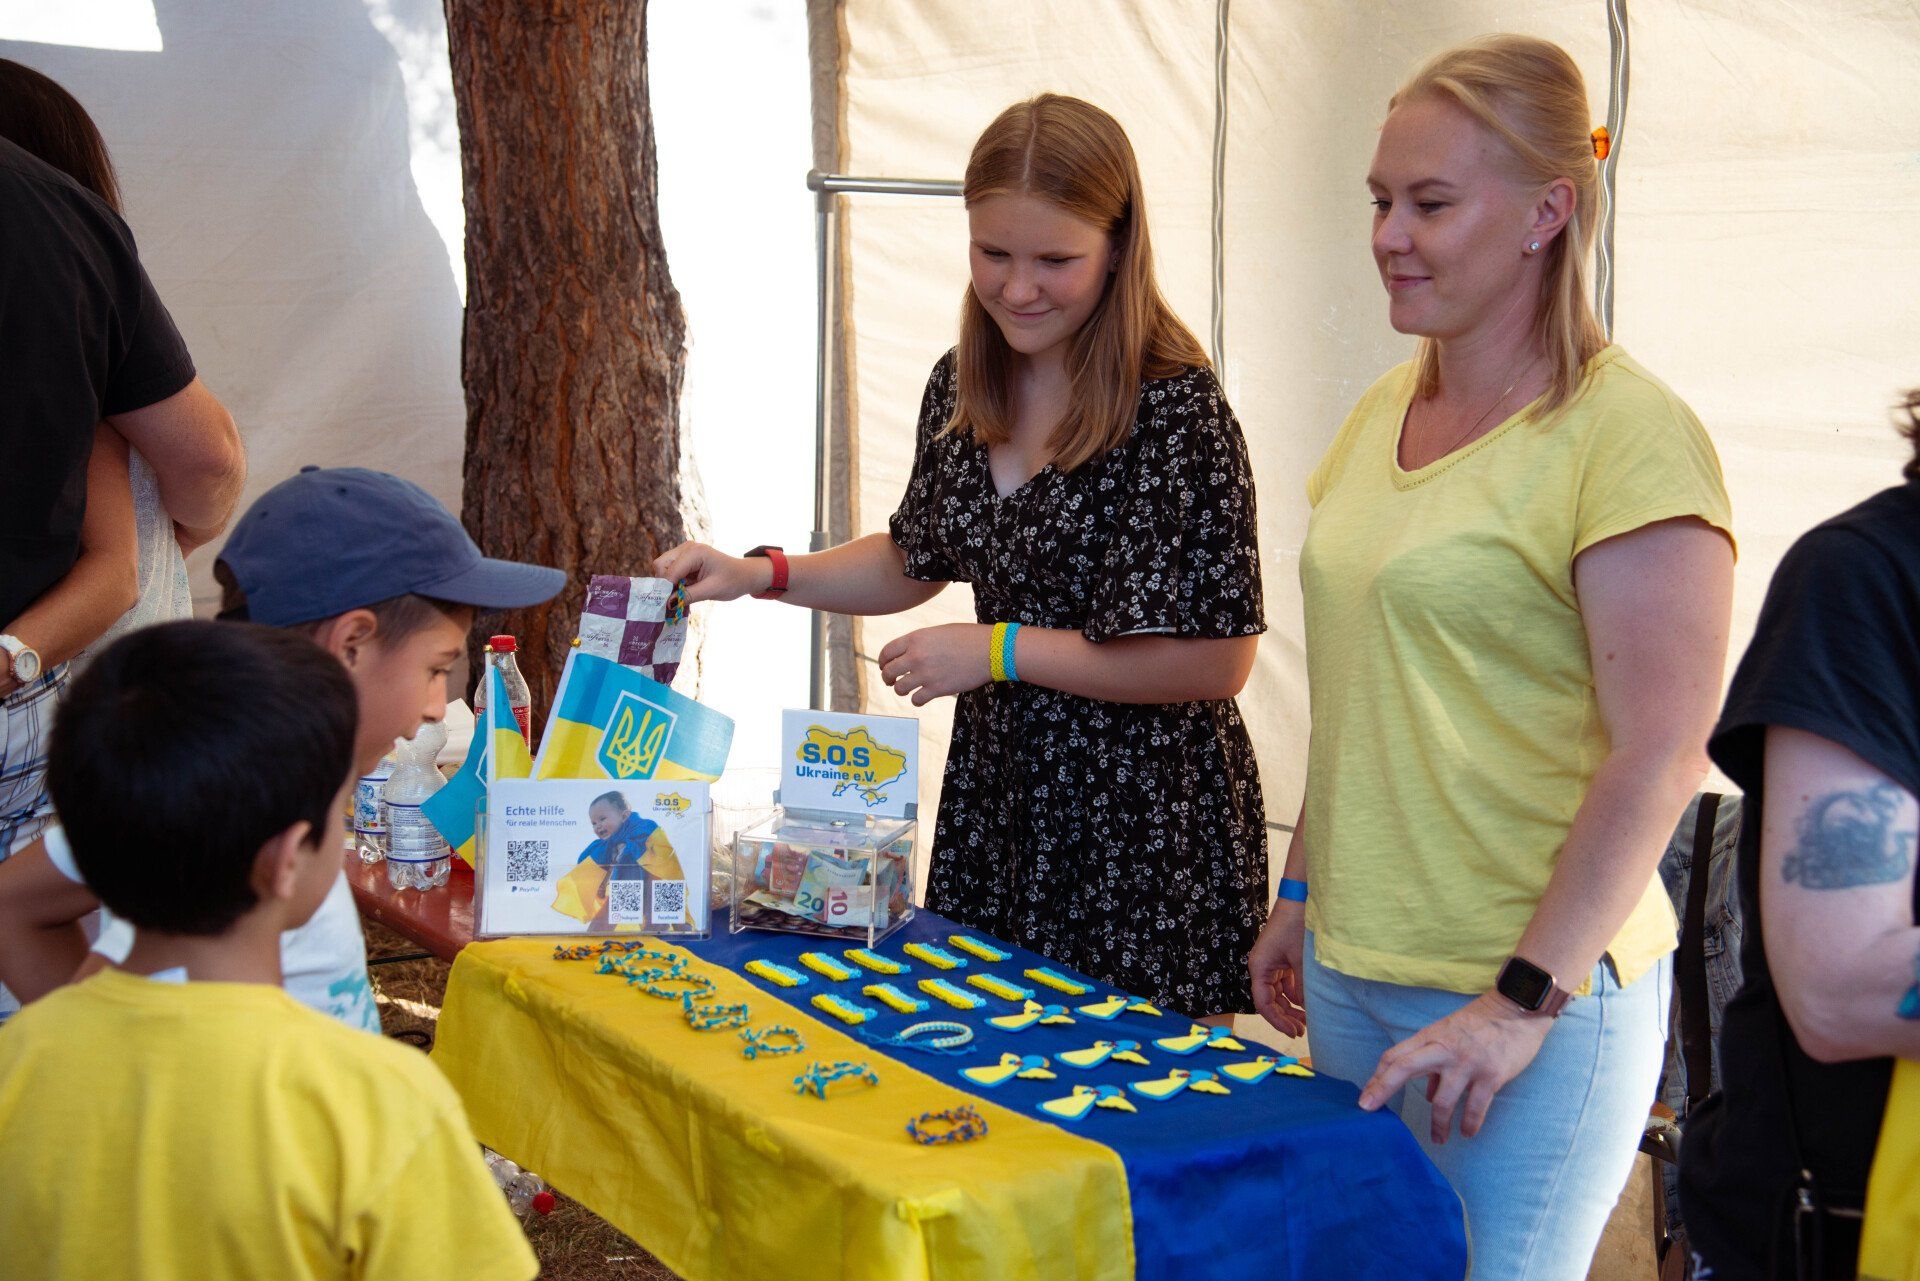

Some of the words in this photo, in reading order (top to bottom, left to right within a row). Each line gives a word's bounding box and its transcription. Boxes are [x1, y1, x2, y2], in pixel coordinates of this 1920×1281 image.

[803, 743, 870, 767] S.O.S
[796, 765, 850, 780] Ukraine
[853, 770, 877, 783] e.V.
[506, 806, 536, 816] Echte
[540, 806, 565, 816] Hilfe
[655, 798, 679, 806] S.O.S
[797, 891, 825, 912] 20
[830, 891, 849, 916] 10
